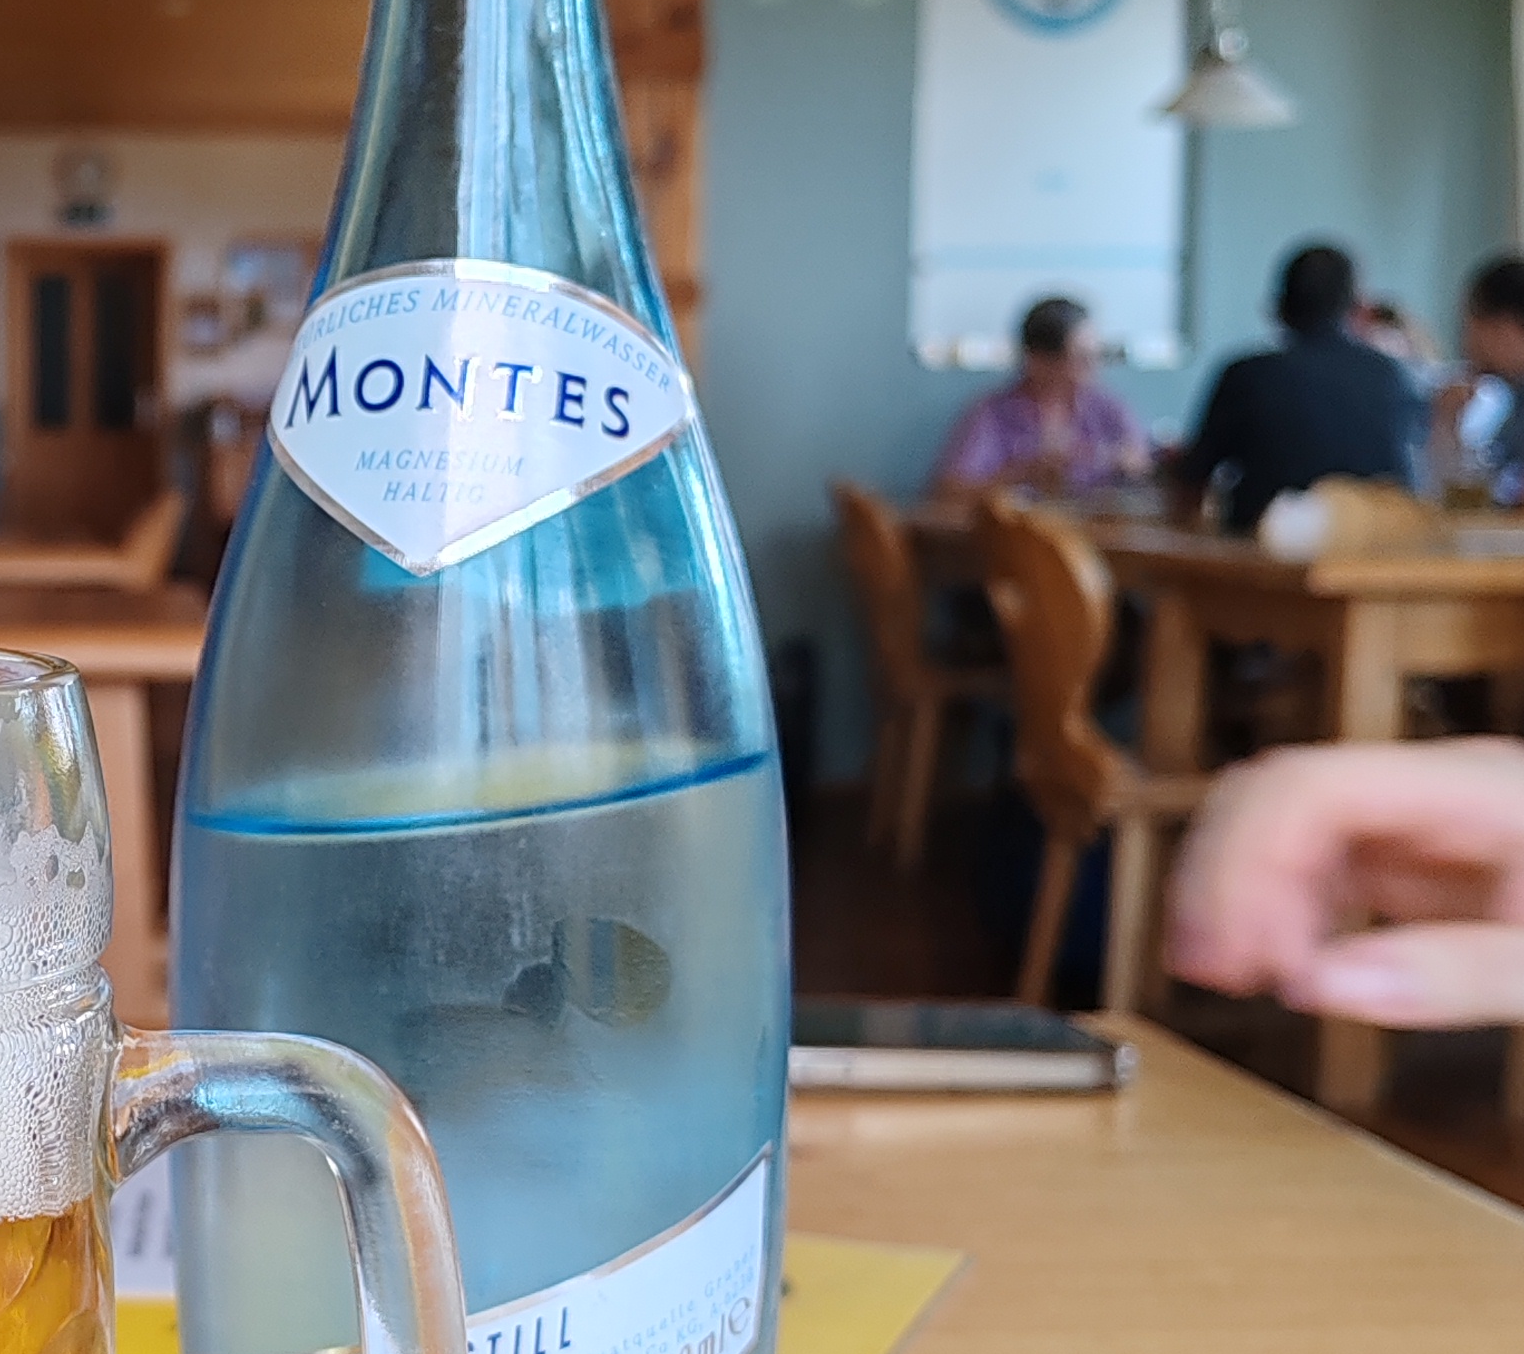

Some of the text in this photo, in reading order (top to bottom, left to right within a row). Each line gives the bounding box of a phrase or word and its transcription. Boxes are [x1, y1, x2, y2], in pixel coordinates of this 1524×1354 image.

[431, 287, 671, 393] MINERALWASSER
[283, 345, 632, 440] MONTES
[354, 448, 525, 478] MAGNESIUM
[381, 481, 485, 505] HALTIG
